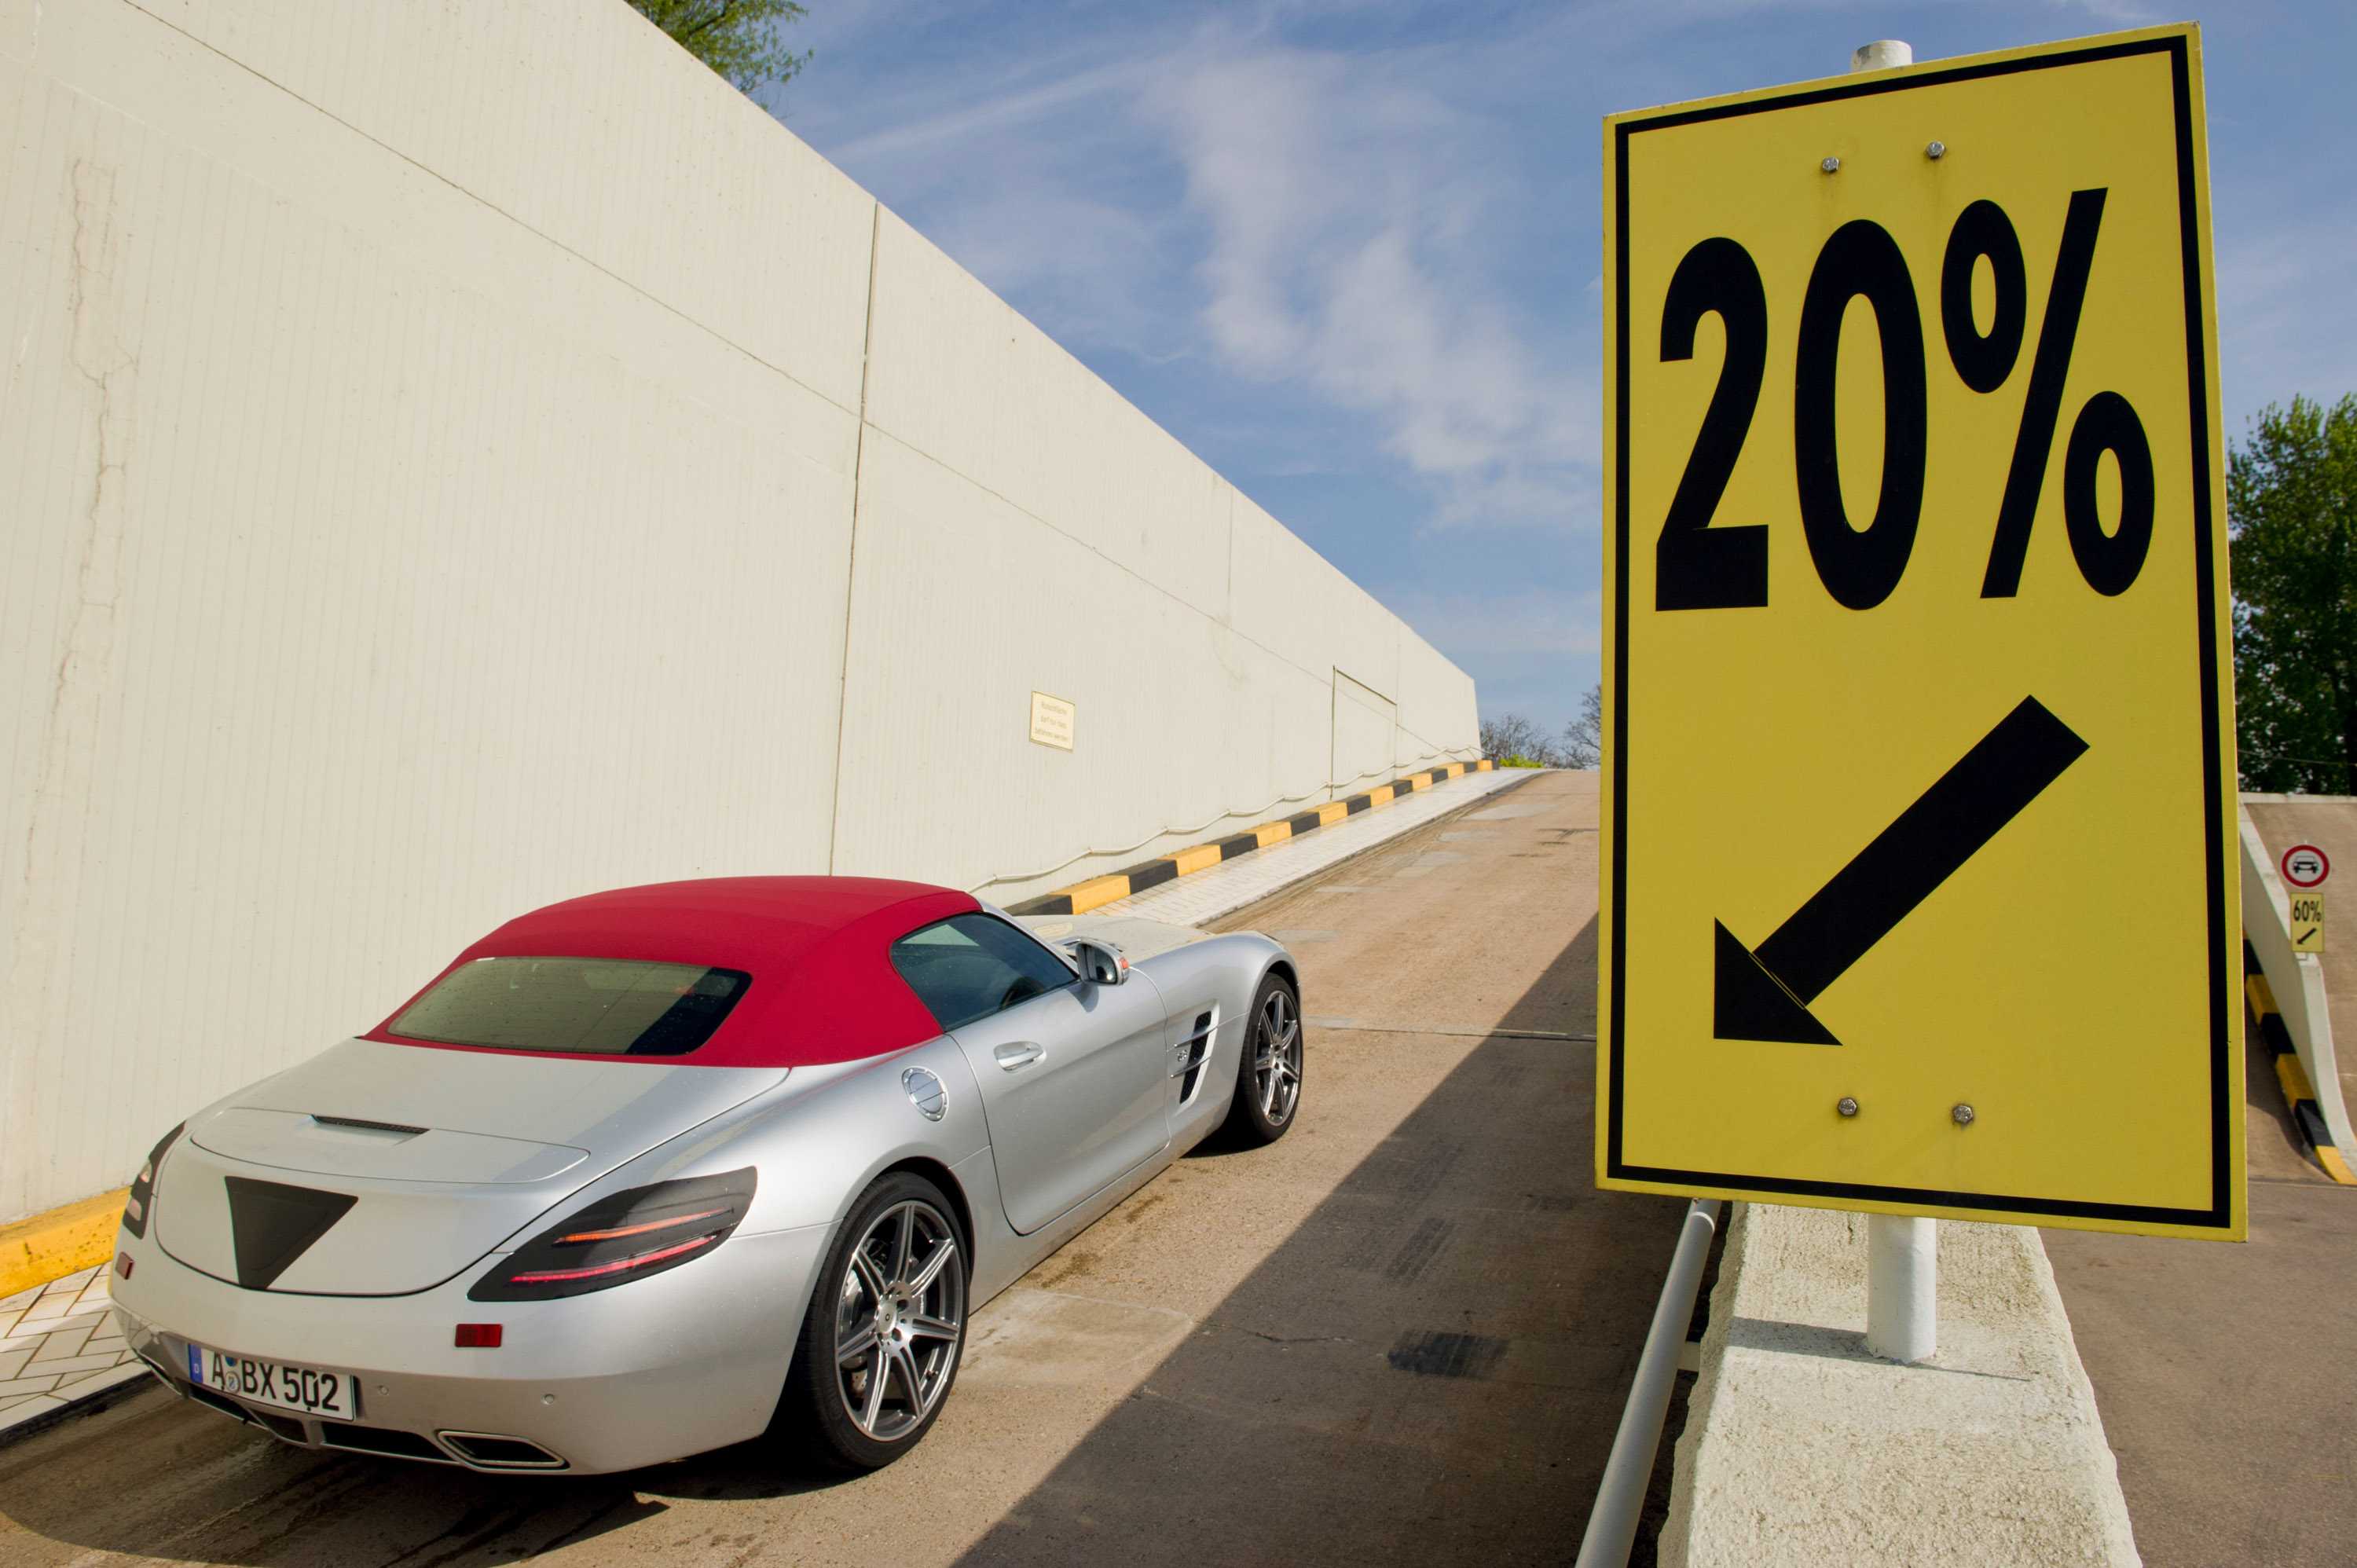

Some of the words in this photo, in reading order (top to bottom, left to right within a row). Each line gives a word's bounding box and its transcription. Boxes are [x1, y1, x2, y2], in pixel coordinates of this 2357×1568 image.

[1655, 186, 2155, 611] 20%
[2293, 900, 2322, 922] 60%
[241, 1360, 277, 1400] BX
[282, 1366, 339, 1412] 502
